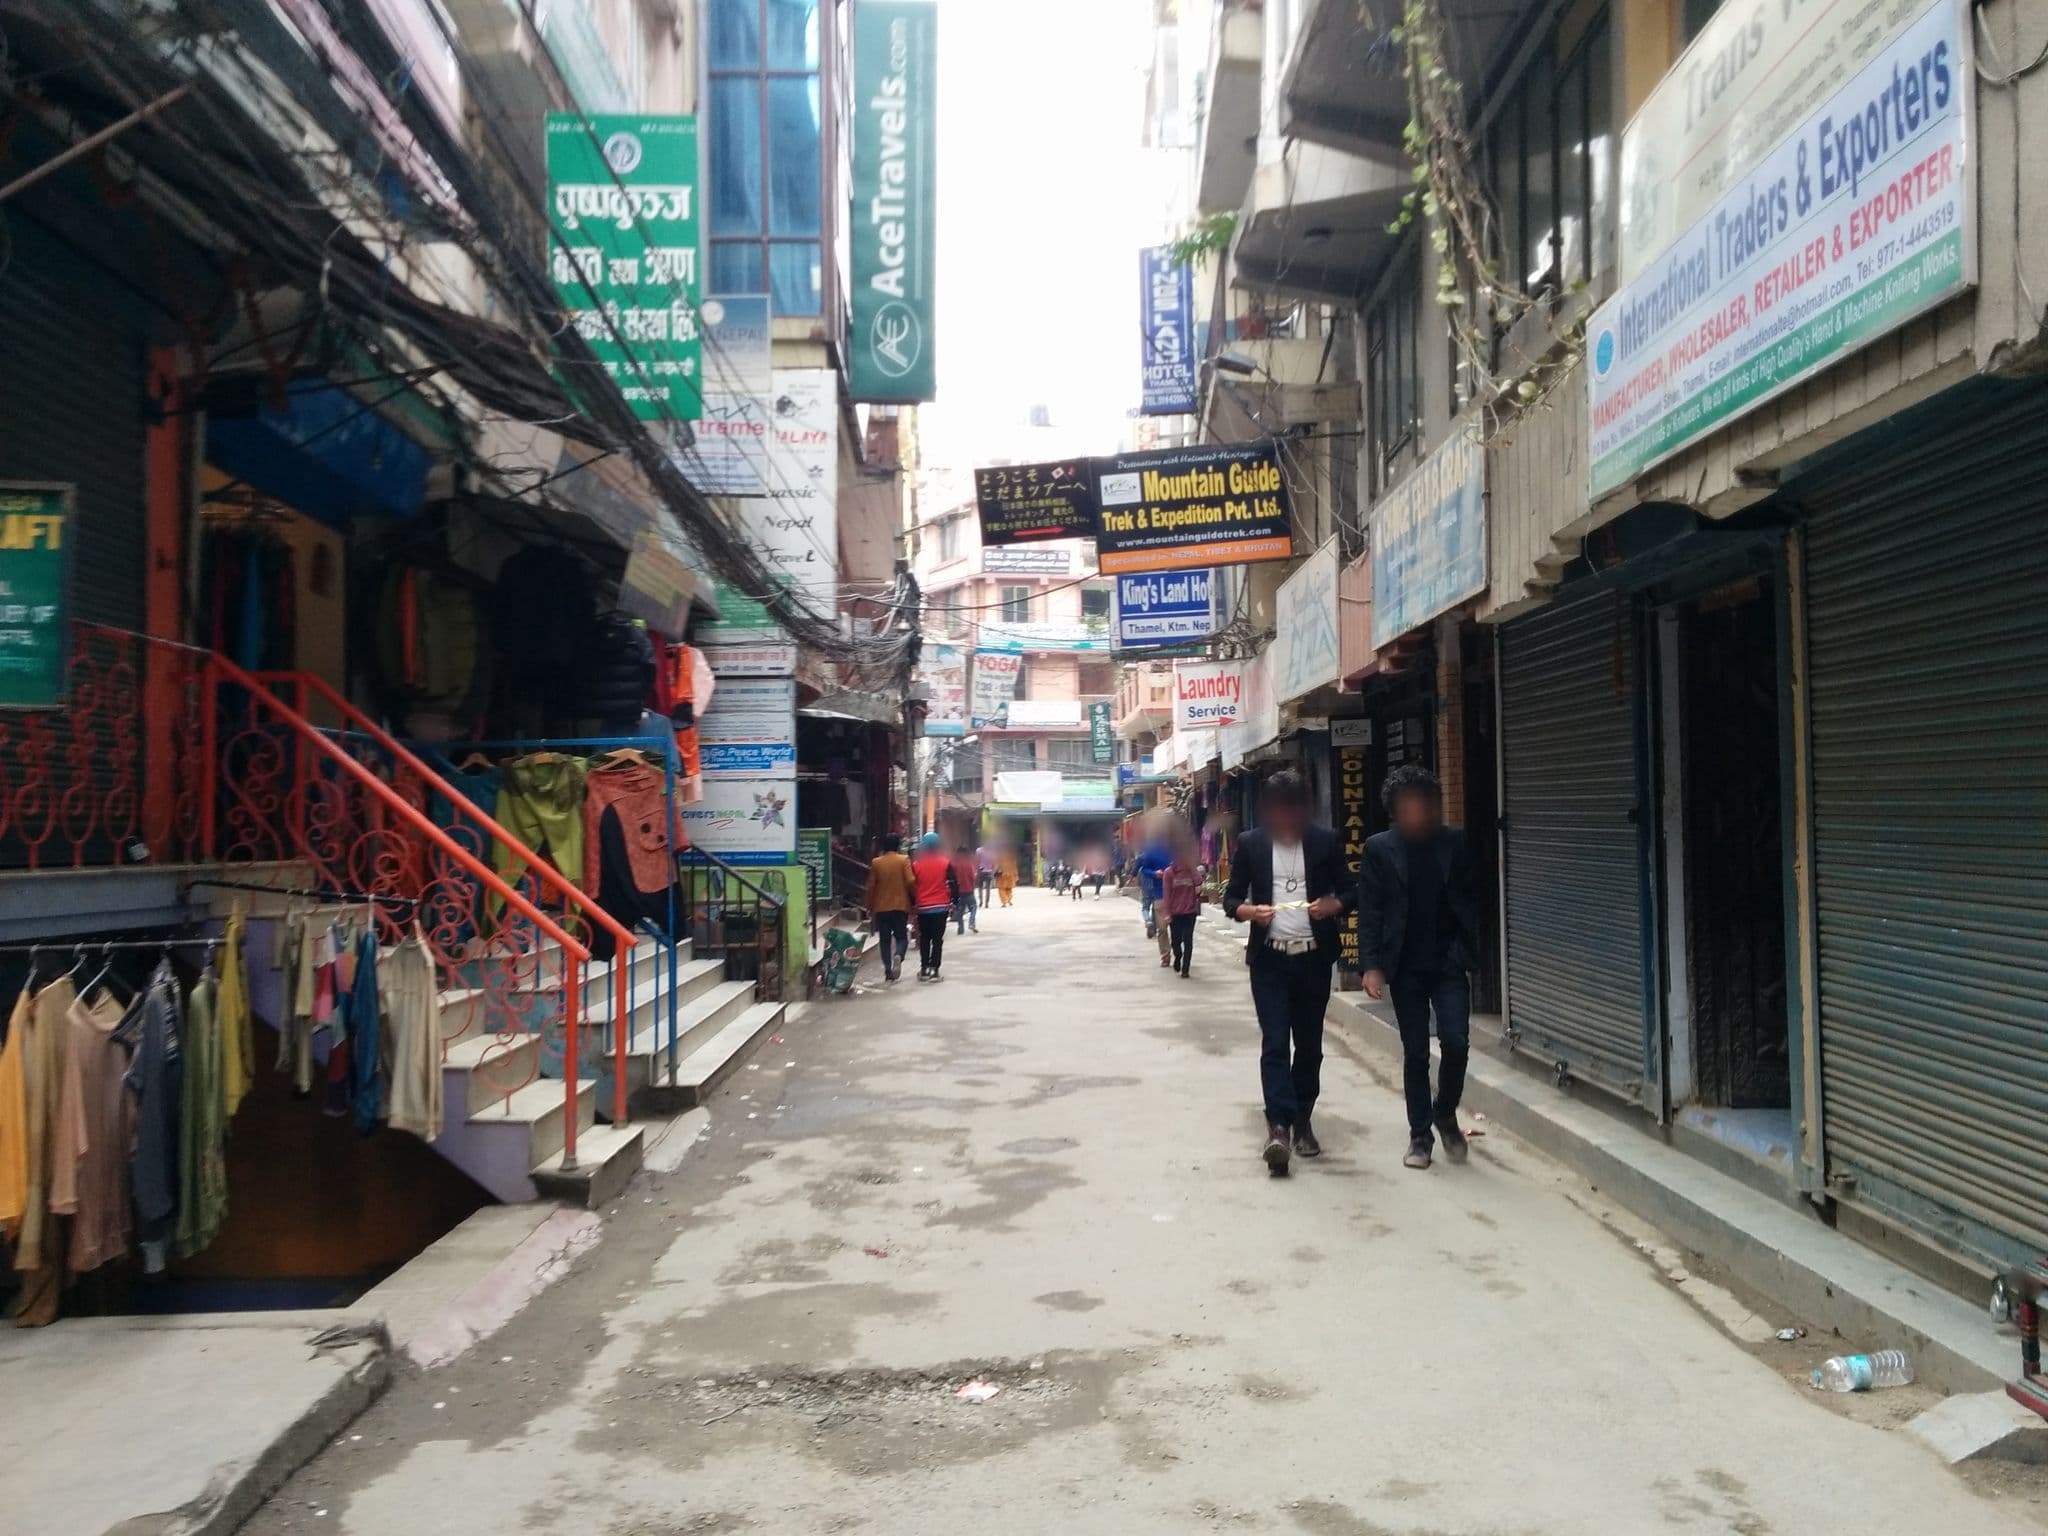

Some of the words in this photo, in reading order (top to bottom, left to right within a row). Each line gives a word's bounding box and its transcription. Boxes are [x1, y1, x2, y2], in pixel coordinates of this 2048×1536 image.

[1619, 238, 1712, 360] International
[1714, 175, 1790, 281] Traders
[1794, 138, 1812, 218] &
[1818, 39, 1951, 201] Exporters
[1857, 258, 1875, 284] Tel:
[1876, 201, 1955, 271] 977-1-4443519
[1669, 294, 1750, 378] WHOLESALER,
[1754, 235, 1826, 317] RETAILER
[1831, 224, 1844, 263] &
[1849, 144, 1952, 251] EXPORTER
[1759, 350, 1777, 381] High
[1834, 310, 1843, 334] &
[1844, 286, 1884, 325] Machine
[1922, 242, 1959, 282] Works.
[1143, 364, 1193, 380] HOTEL
[697, 420, 765, 436] treme
[981, 467, 1038, 486] ようこそ
[1143, 466, 1226, 503] Mountain
[1229, 460, 1281, 495] Guide
[982, 481, 1087, 501] こだまツアーへ
[1102, 511, 1134, 532] Trek
[1136, 507, 1149, 529] &
[1151, 503, 1223, 531] Expedition
[1225, 500, 1252, 522] Pvt.
[1255, 496, 1282, 518] Ltd.
[1116, 527, 1272, 549] www.mountainguidetrek.com
[1122, 577, 1157, 611] King's
[1160, 576, 1189, 604] Land
[1128, 622, 1166, 634] Thamel,
[1168, 619, 1190, 632] Ktm.
[977, 655, 1019, 672] YOGA
[1178, 670, 1241, 703] Laundry
[1188, 704, 1236, 718] Service
[761, 746, 793, 756] World
